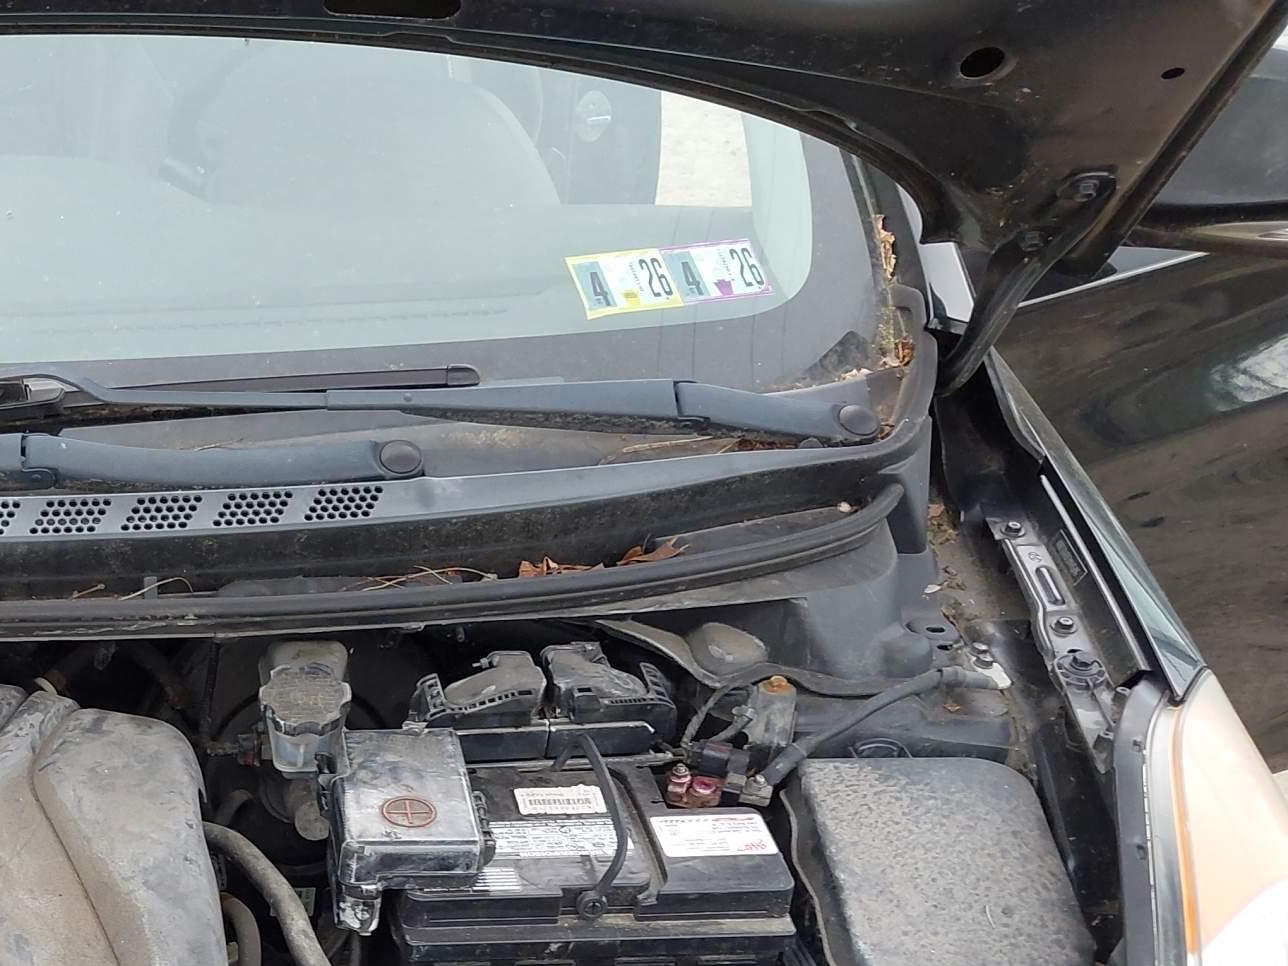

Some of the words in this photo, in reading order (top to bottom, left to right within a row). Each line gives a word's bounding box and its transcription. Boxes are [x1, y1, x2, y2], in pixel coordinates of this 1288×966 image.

[590, 271, 612, 307] 4
[639, 257, 673, 298] 26
[682, 261, 704, 296] 4
[730, 247, 765, 287] 26
